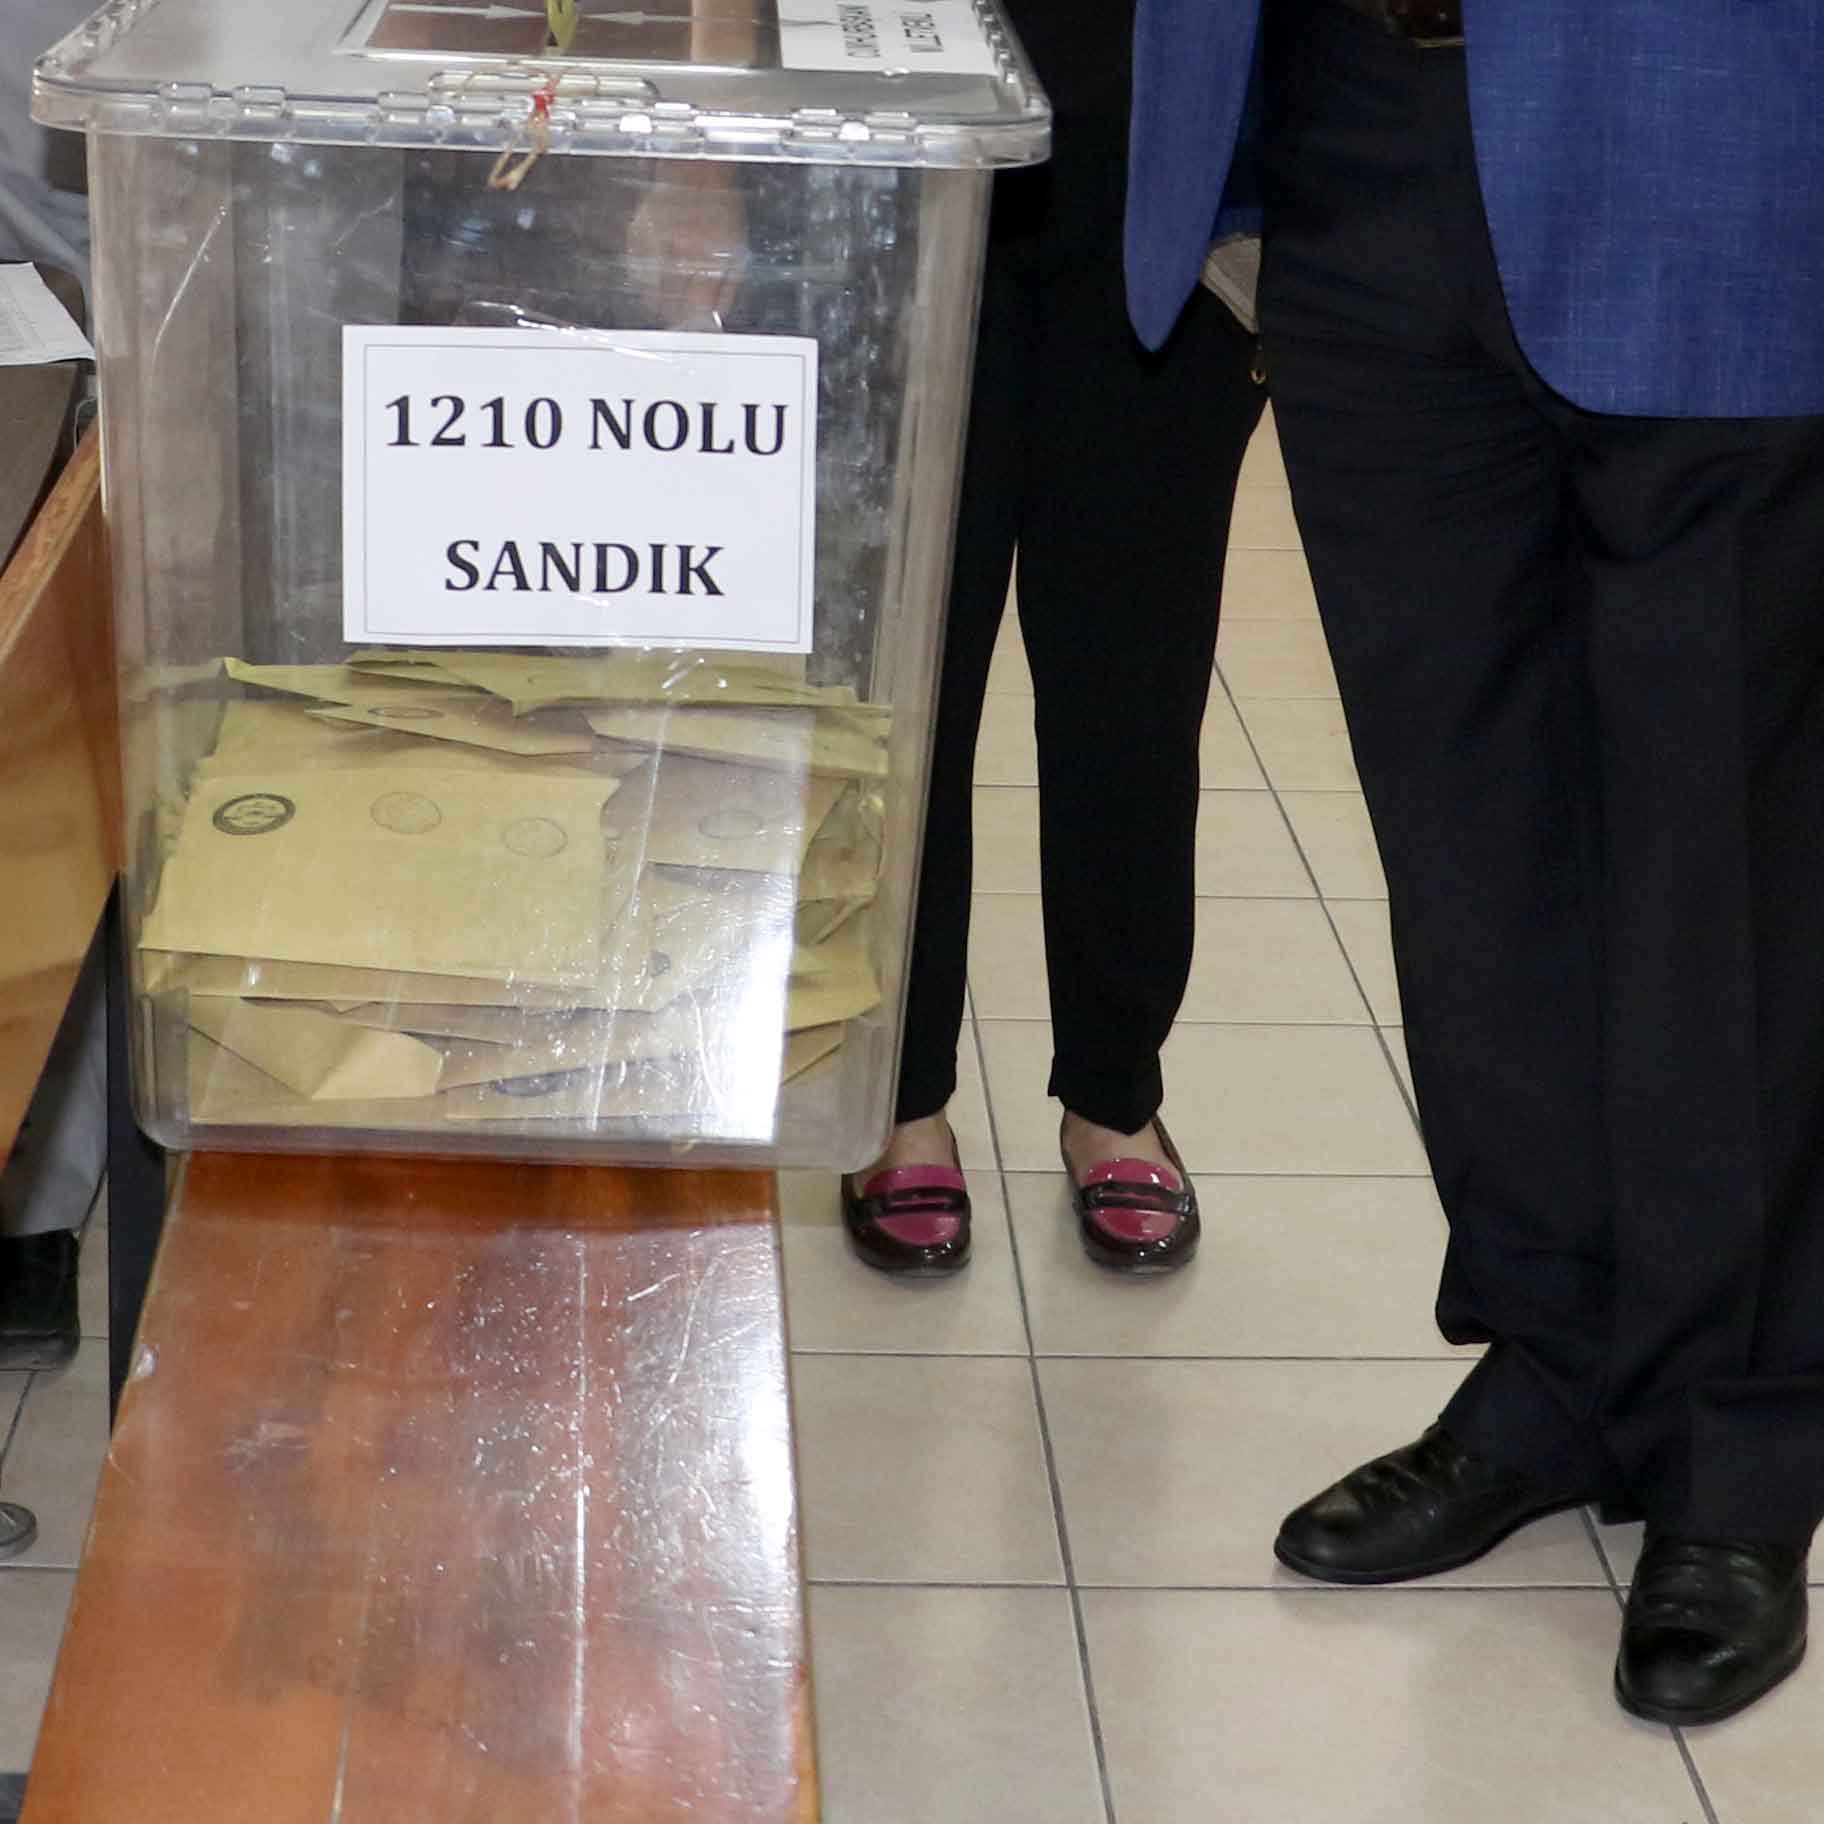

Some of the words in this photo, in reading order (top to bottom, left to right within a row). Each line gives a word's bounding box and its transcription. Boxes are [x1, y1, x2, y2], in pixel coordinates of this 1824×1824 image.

[385, 395, 562, 449] 1210
[587, 398, 788, 455] NOLU
[444, 539, 725, 596] SANDIK
